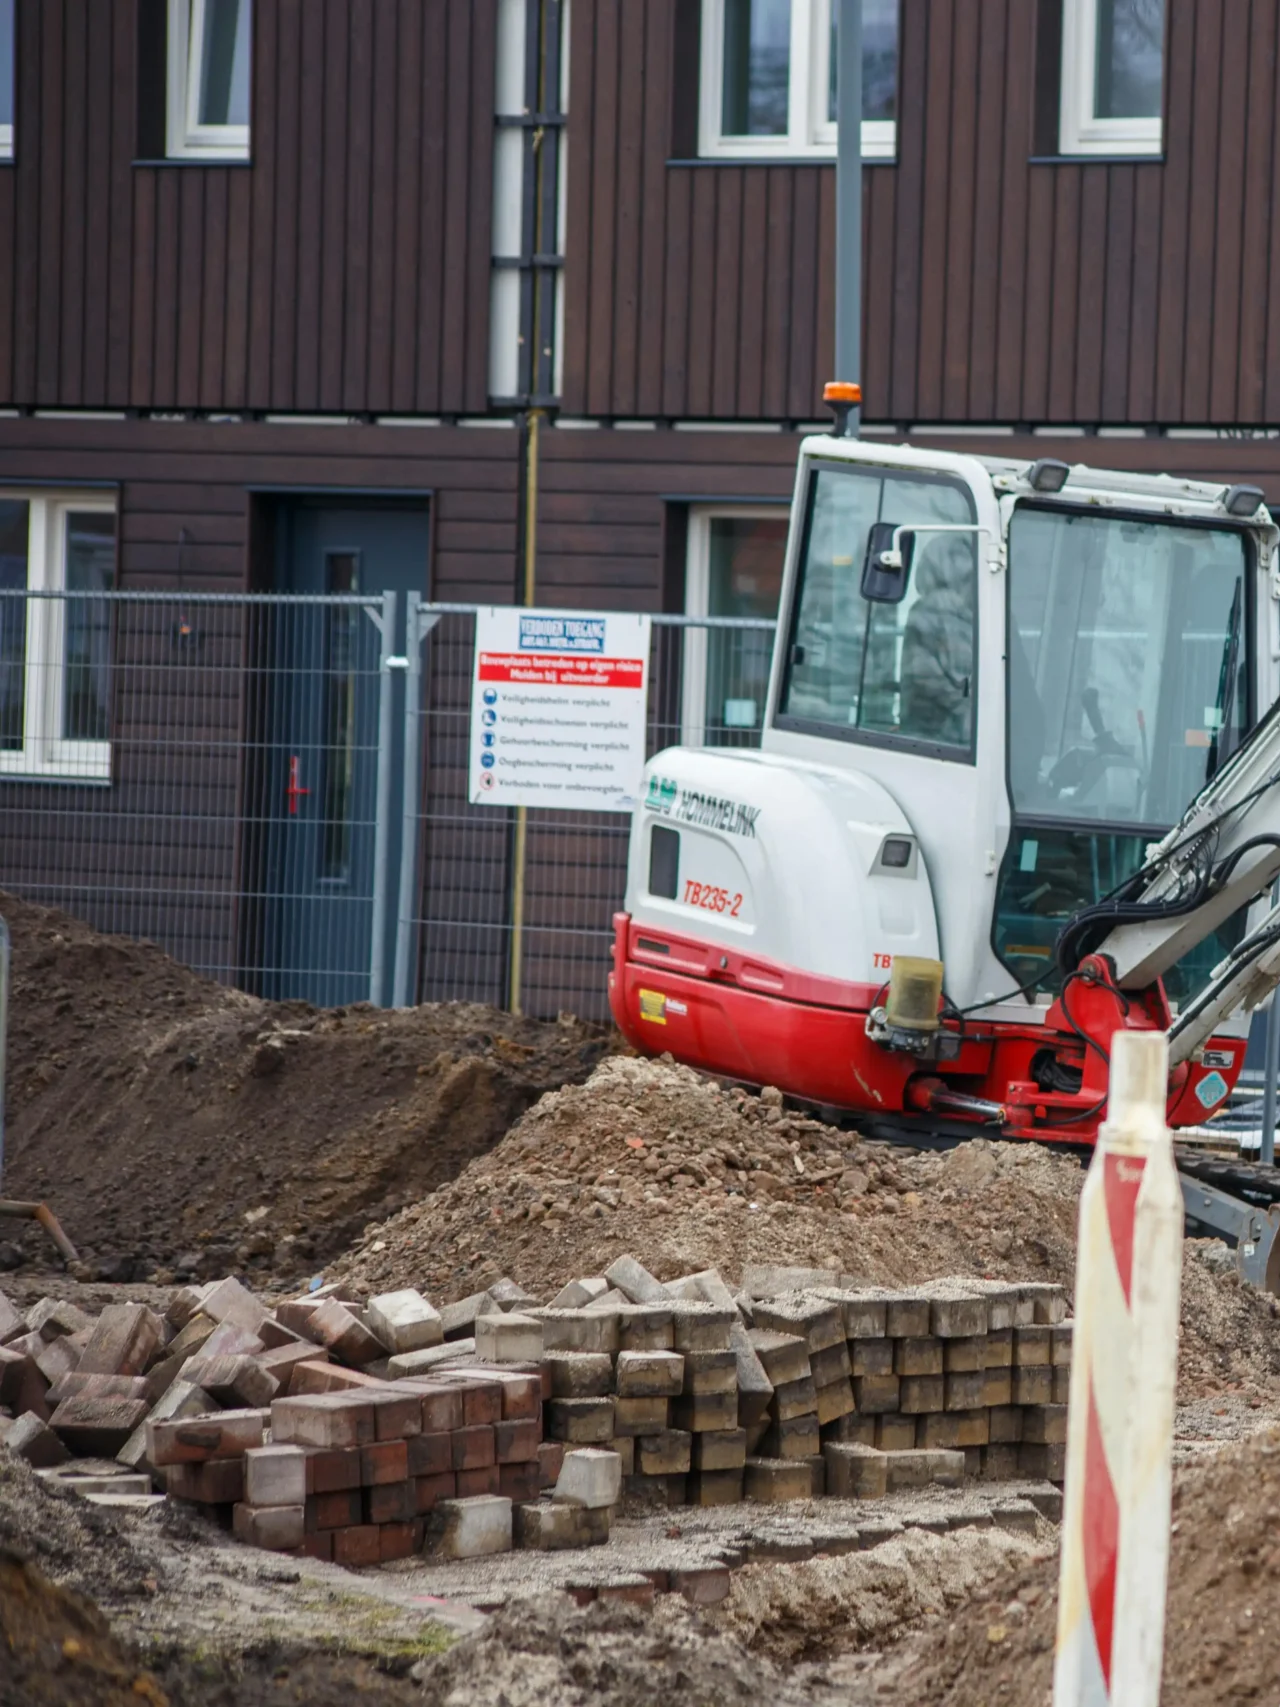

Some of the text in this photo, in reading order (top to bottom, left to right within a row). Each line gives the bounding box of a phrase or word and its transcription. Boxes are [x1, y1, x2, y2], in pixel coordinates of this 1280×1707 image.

[675, 789, 762, 839] HOMMELINK
[684, 879, 744, 918] TB235-2
[873, 952, 894, 970] TB
